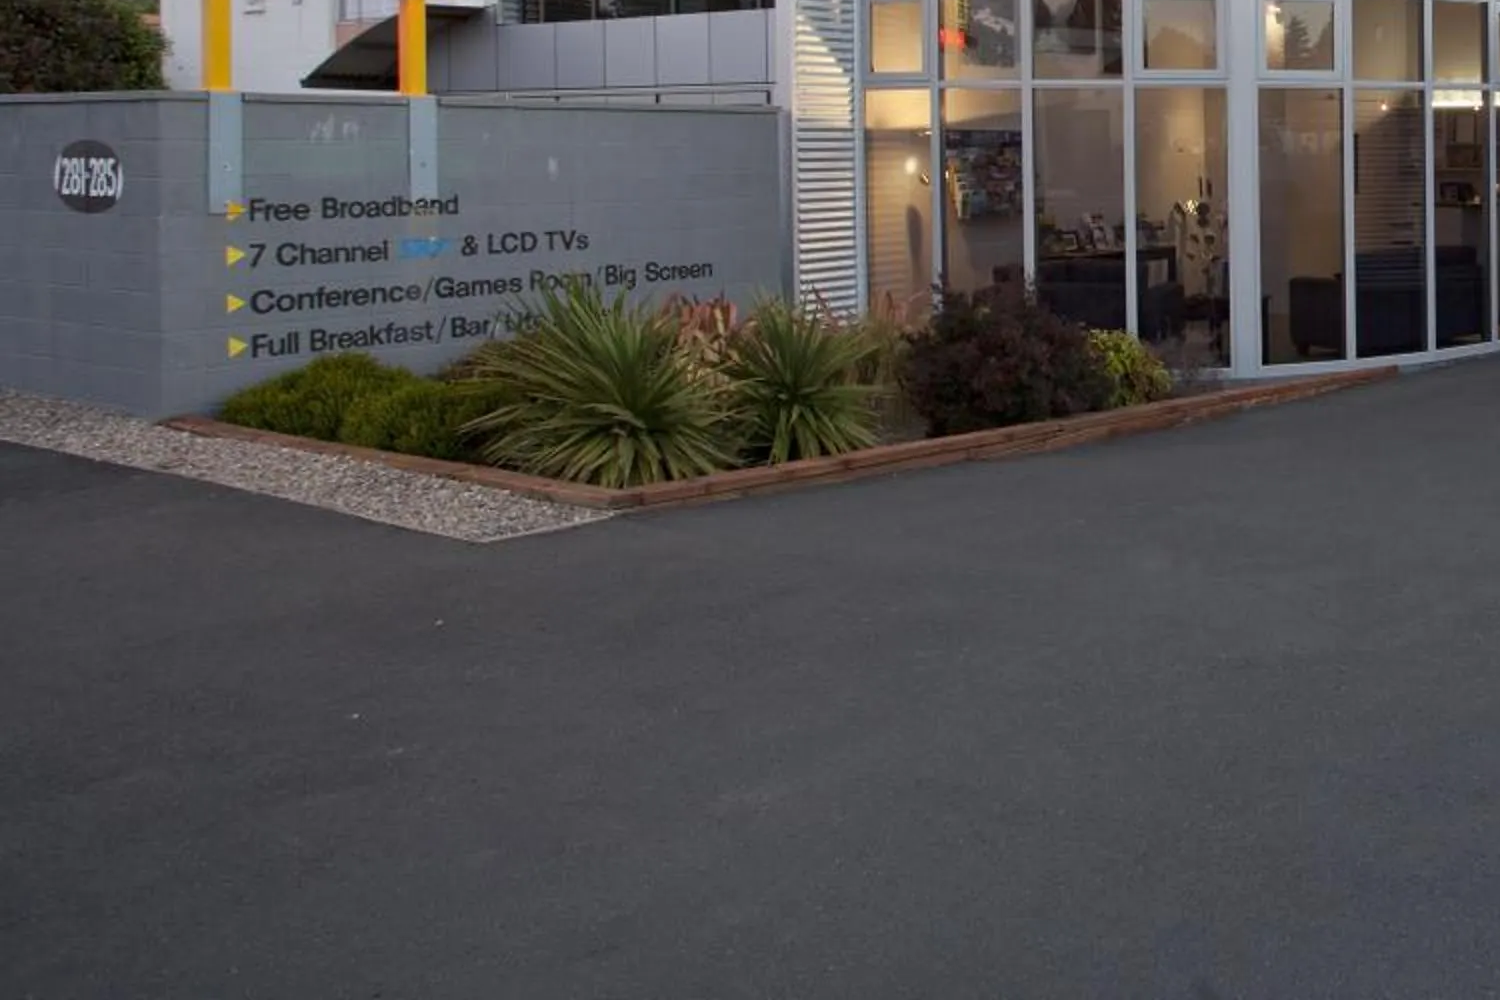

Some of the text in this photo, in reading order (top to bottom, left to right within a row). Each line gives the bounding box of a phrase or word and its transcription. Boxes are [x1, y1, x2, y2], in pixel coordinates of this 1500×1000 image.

[250, 194, 459, 222] Free Broadband
[248, 243, 267, 268] 7
[276, 239, 390, 266] Channel
[460, 234, 479, 256] &
[487, 230, 538, 255] LCD
[543, 229, 590, 251] TVs
[645, 261, 714, 283] Screen
[251, 331, 300, 358] Full
